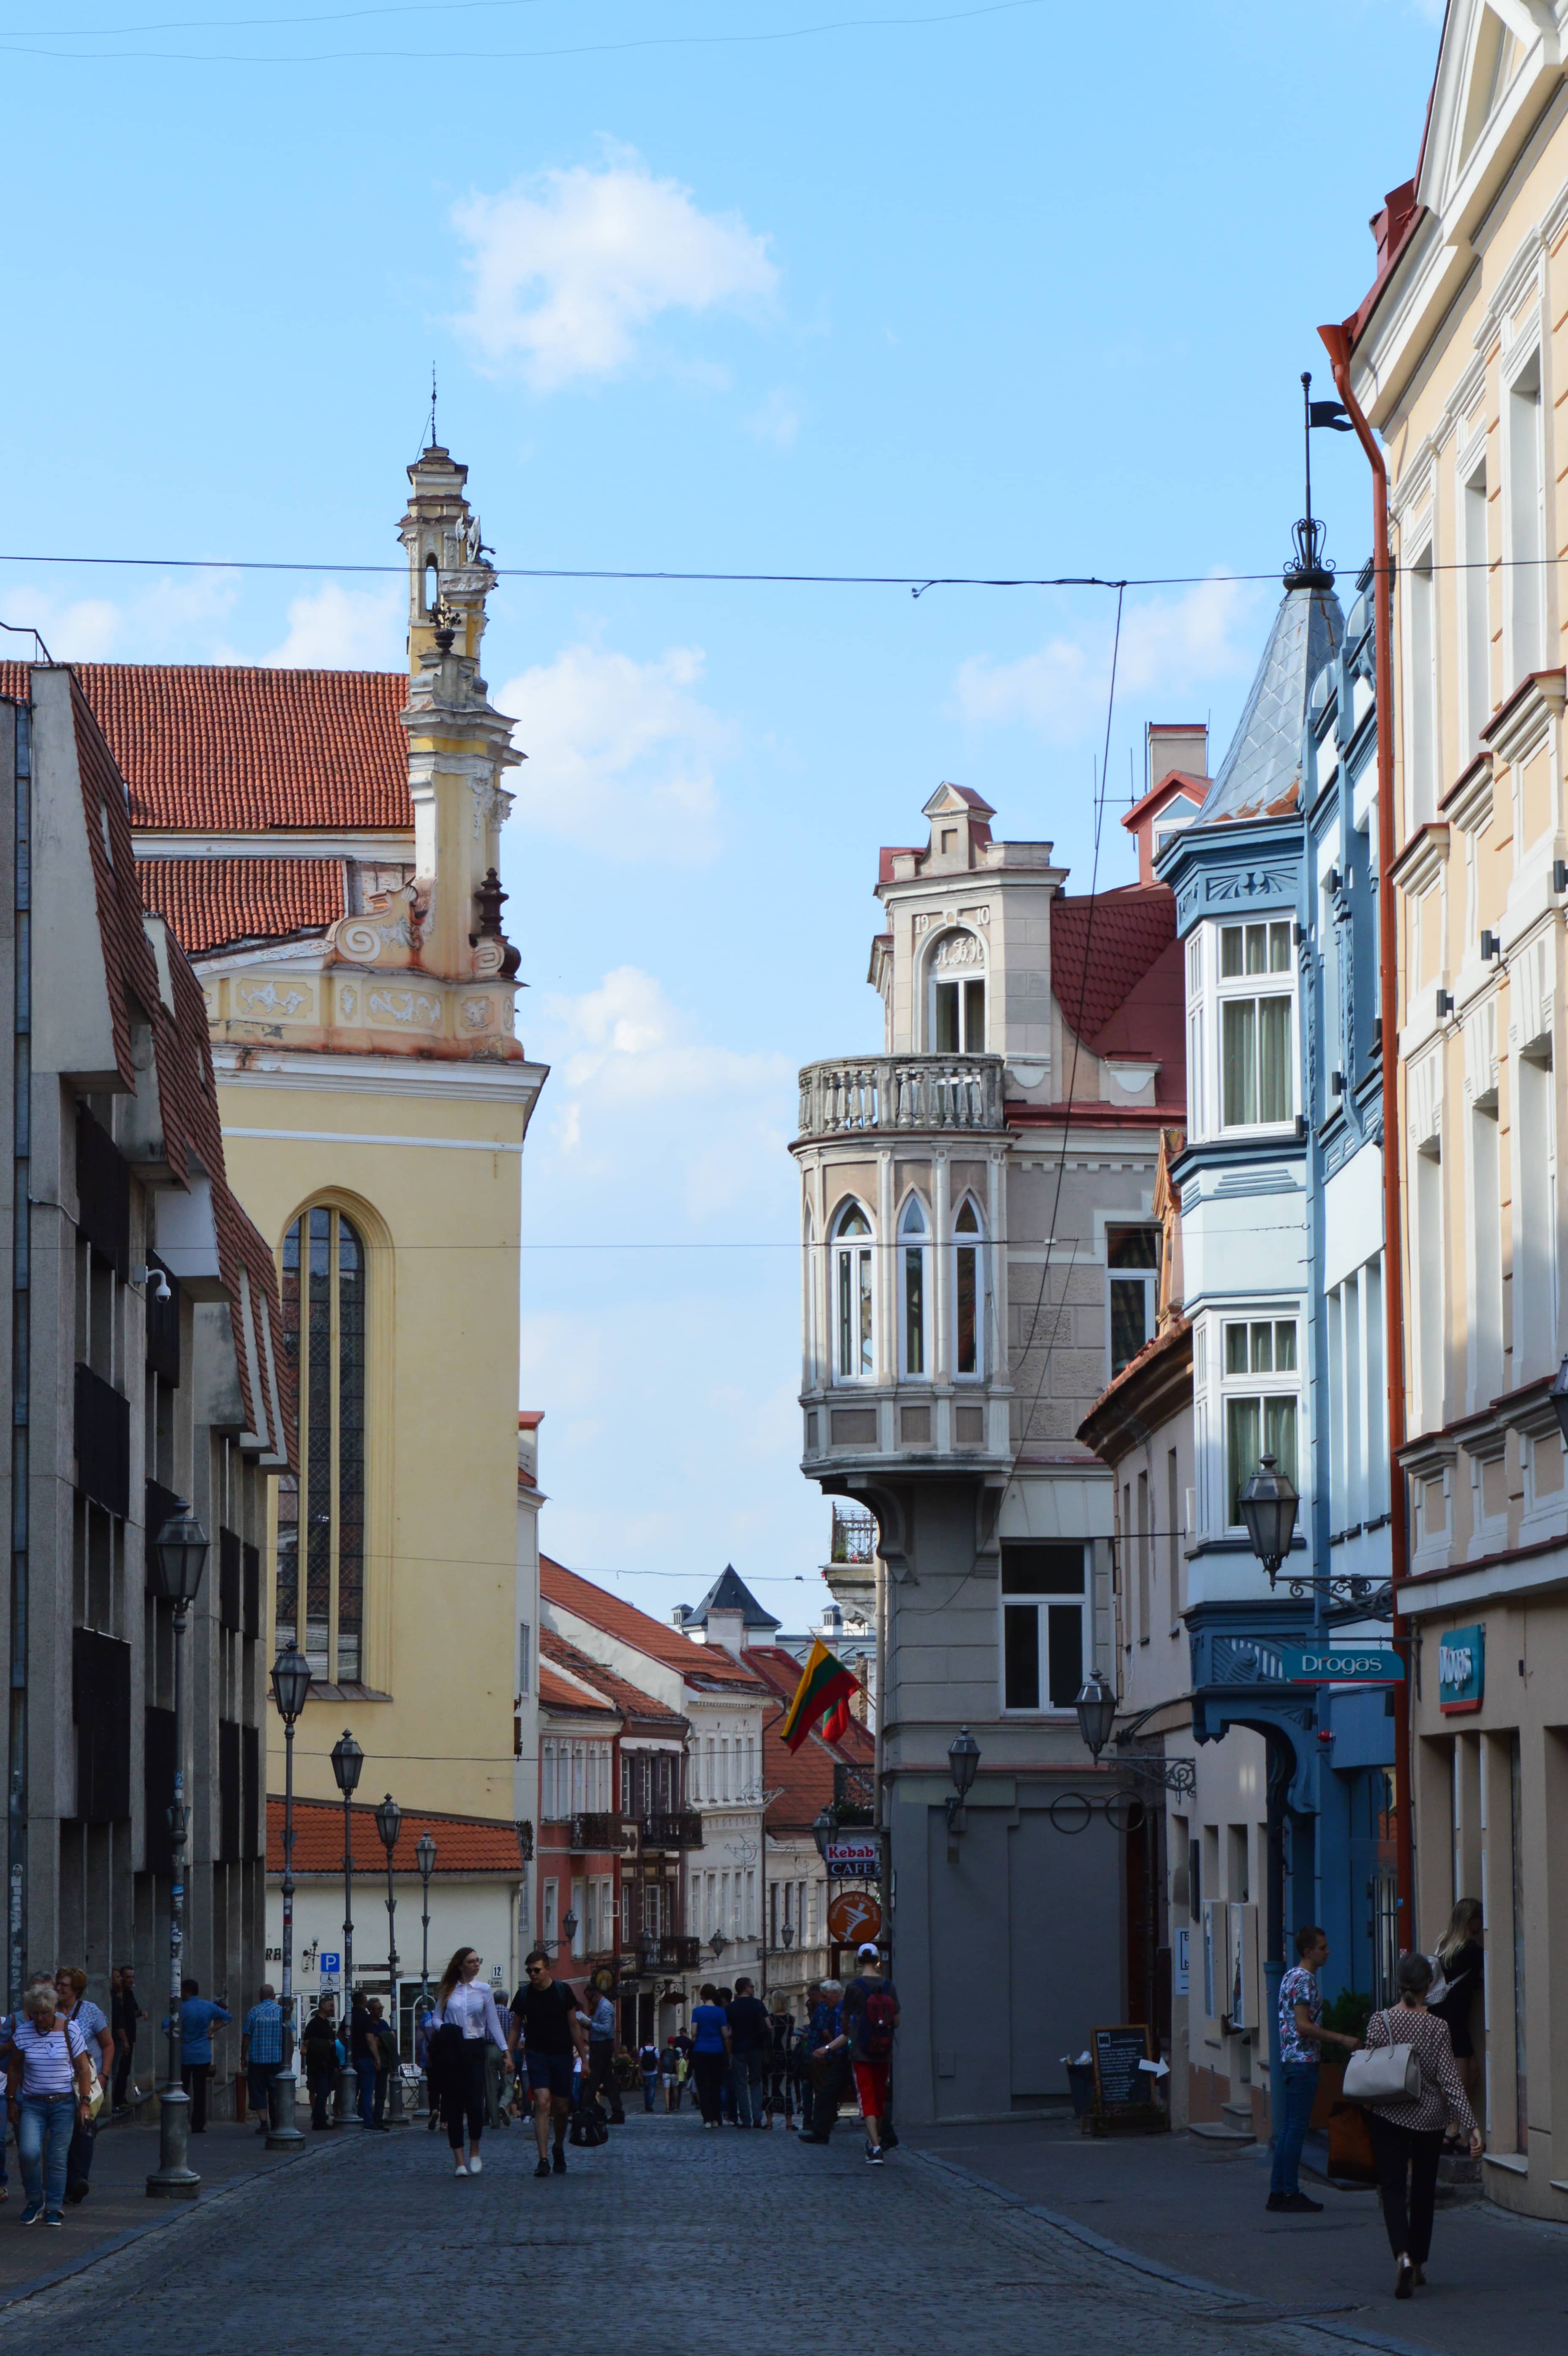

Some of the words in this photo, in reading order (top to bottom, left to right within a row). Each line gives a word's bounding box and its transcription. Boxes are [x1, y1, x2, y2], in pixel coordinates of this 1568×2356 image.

[1302, 1655, 1382, 1675] Drogas
[1439, 1646, 1472, 1690] Drogas
[828, 1846, 874, 1858] Kebab
[831, 1863, 872, 1875] CAFE
[326, 1955, 336, 1970] P
[494, 1966, 501, 1976] 12
